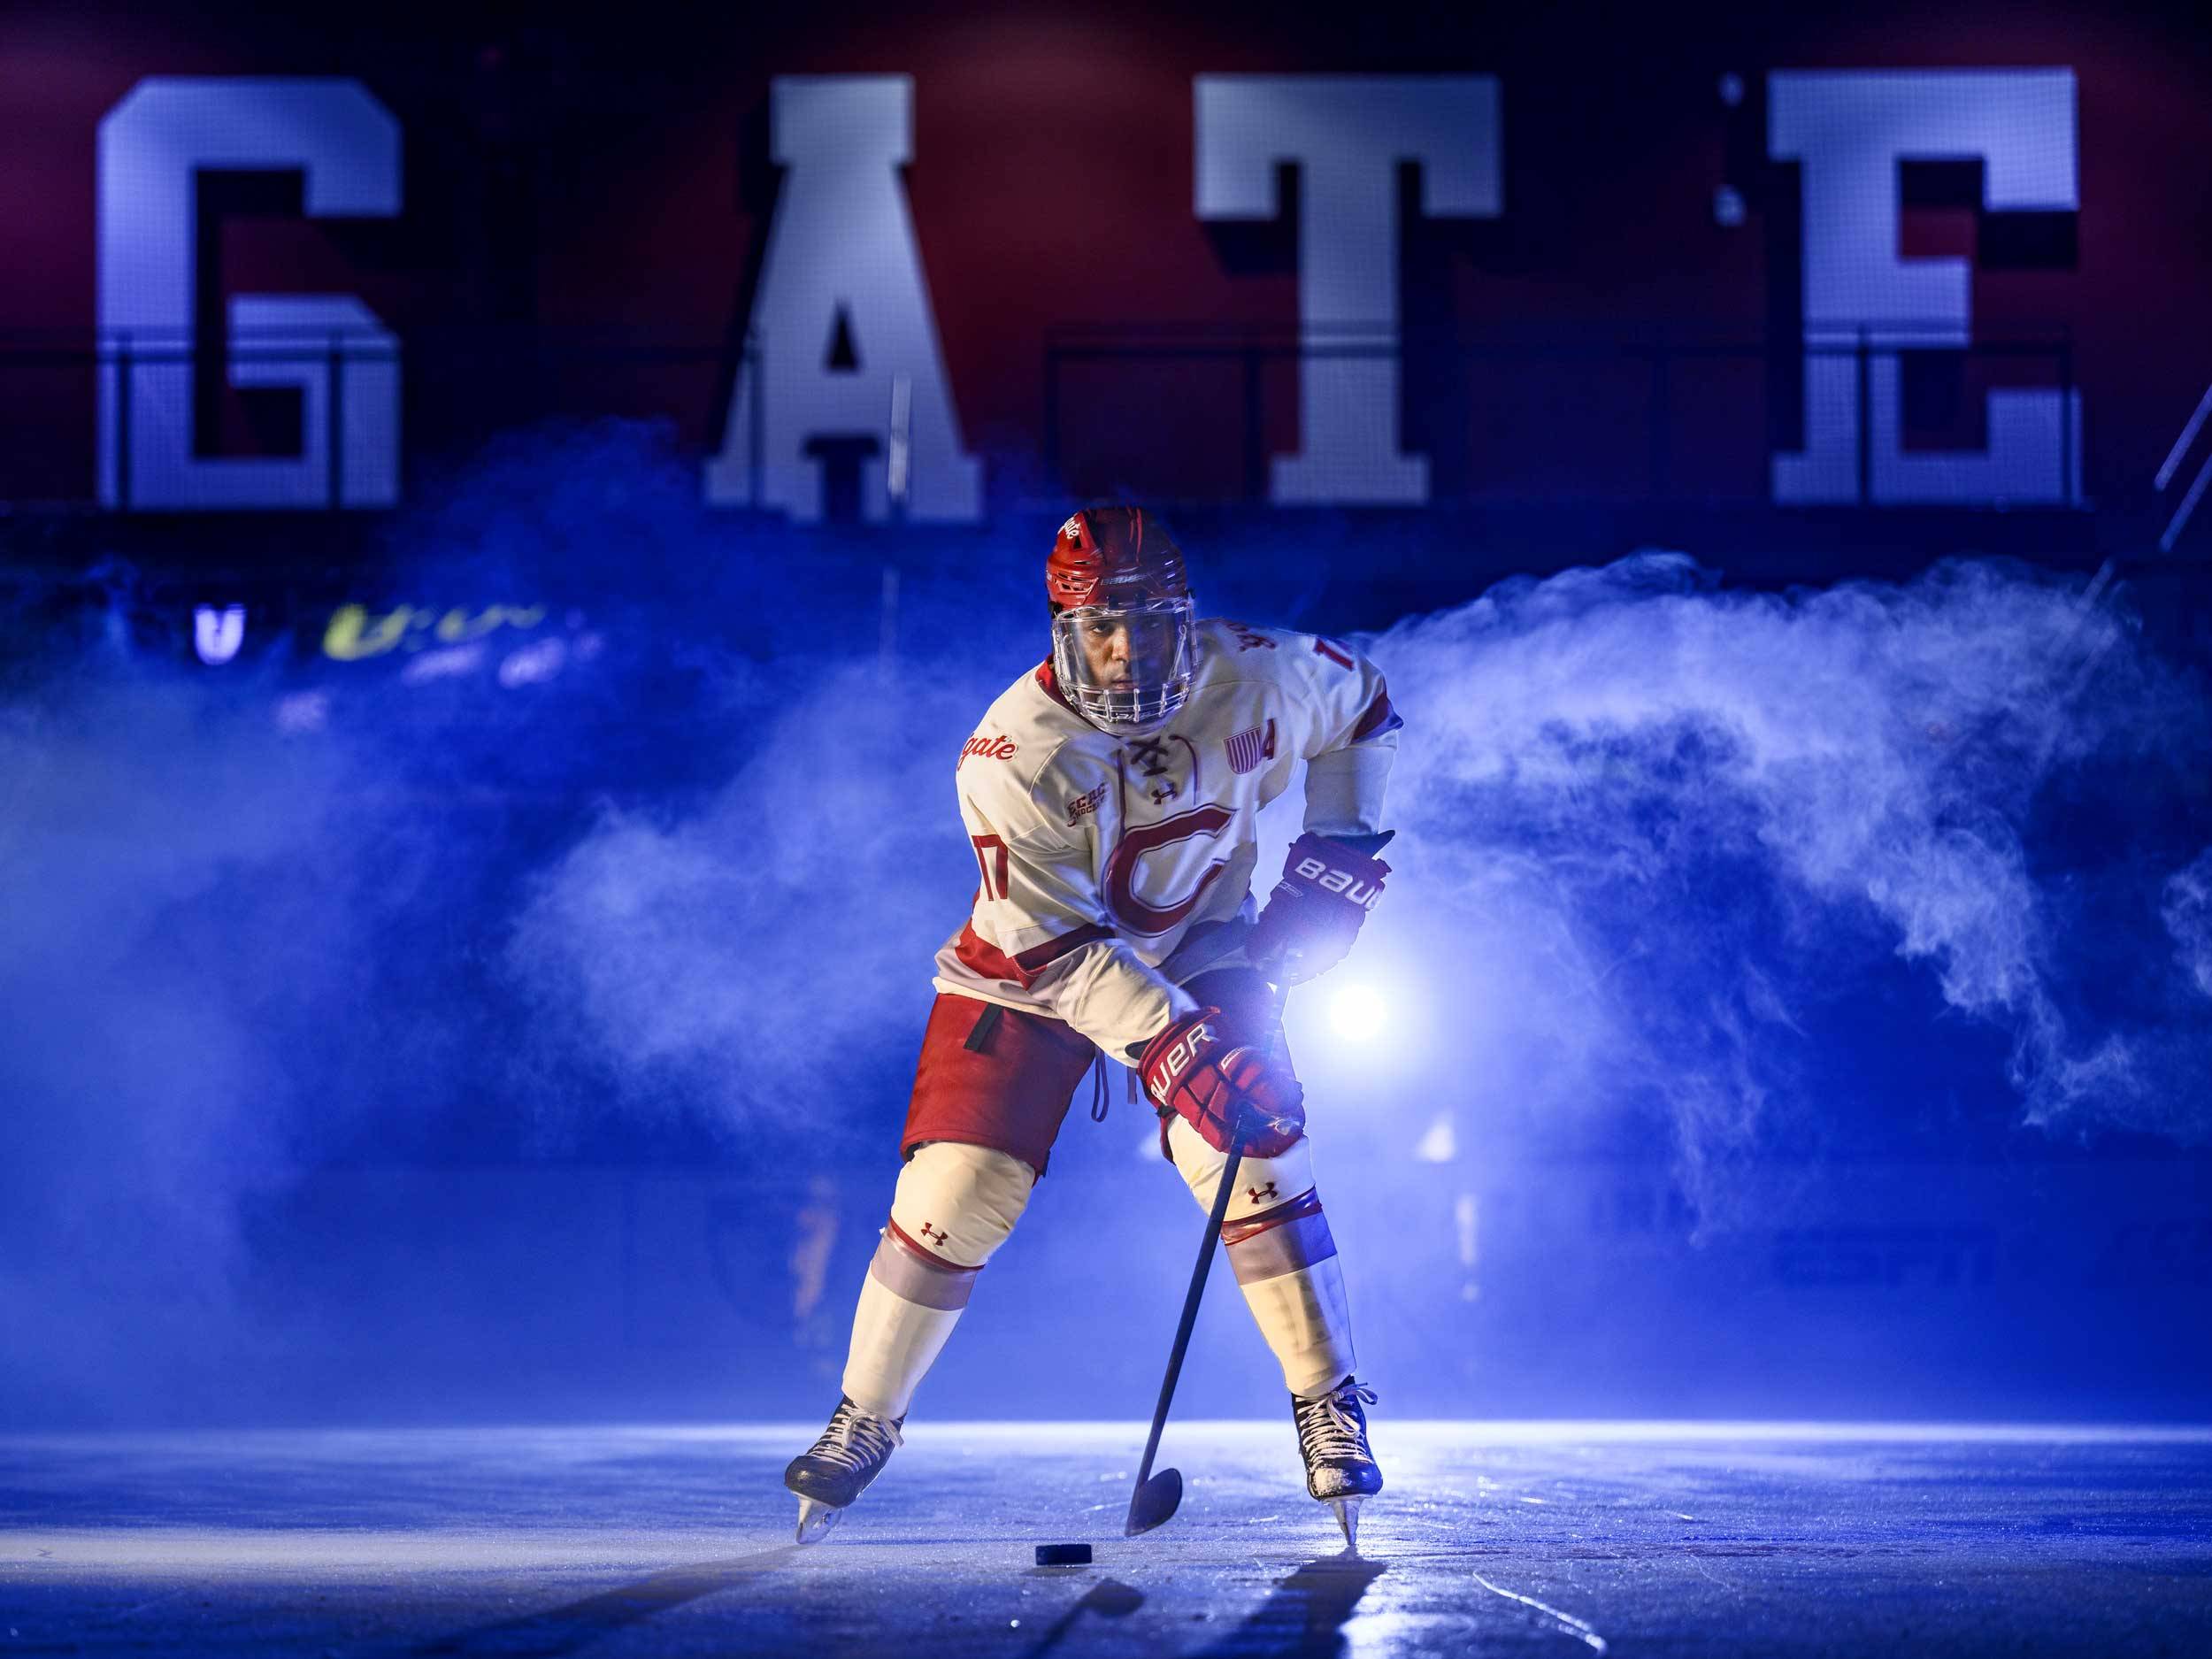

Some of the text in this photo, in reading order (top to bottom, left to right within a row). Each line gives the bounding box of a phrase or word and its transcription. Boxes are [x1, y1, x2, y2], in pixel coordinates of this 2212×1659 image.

[97, 67, 2083, 524] GATE
[956, 733, 1018, 772] gate
[1102, 804, 1233, 938] C
